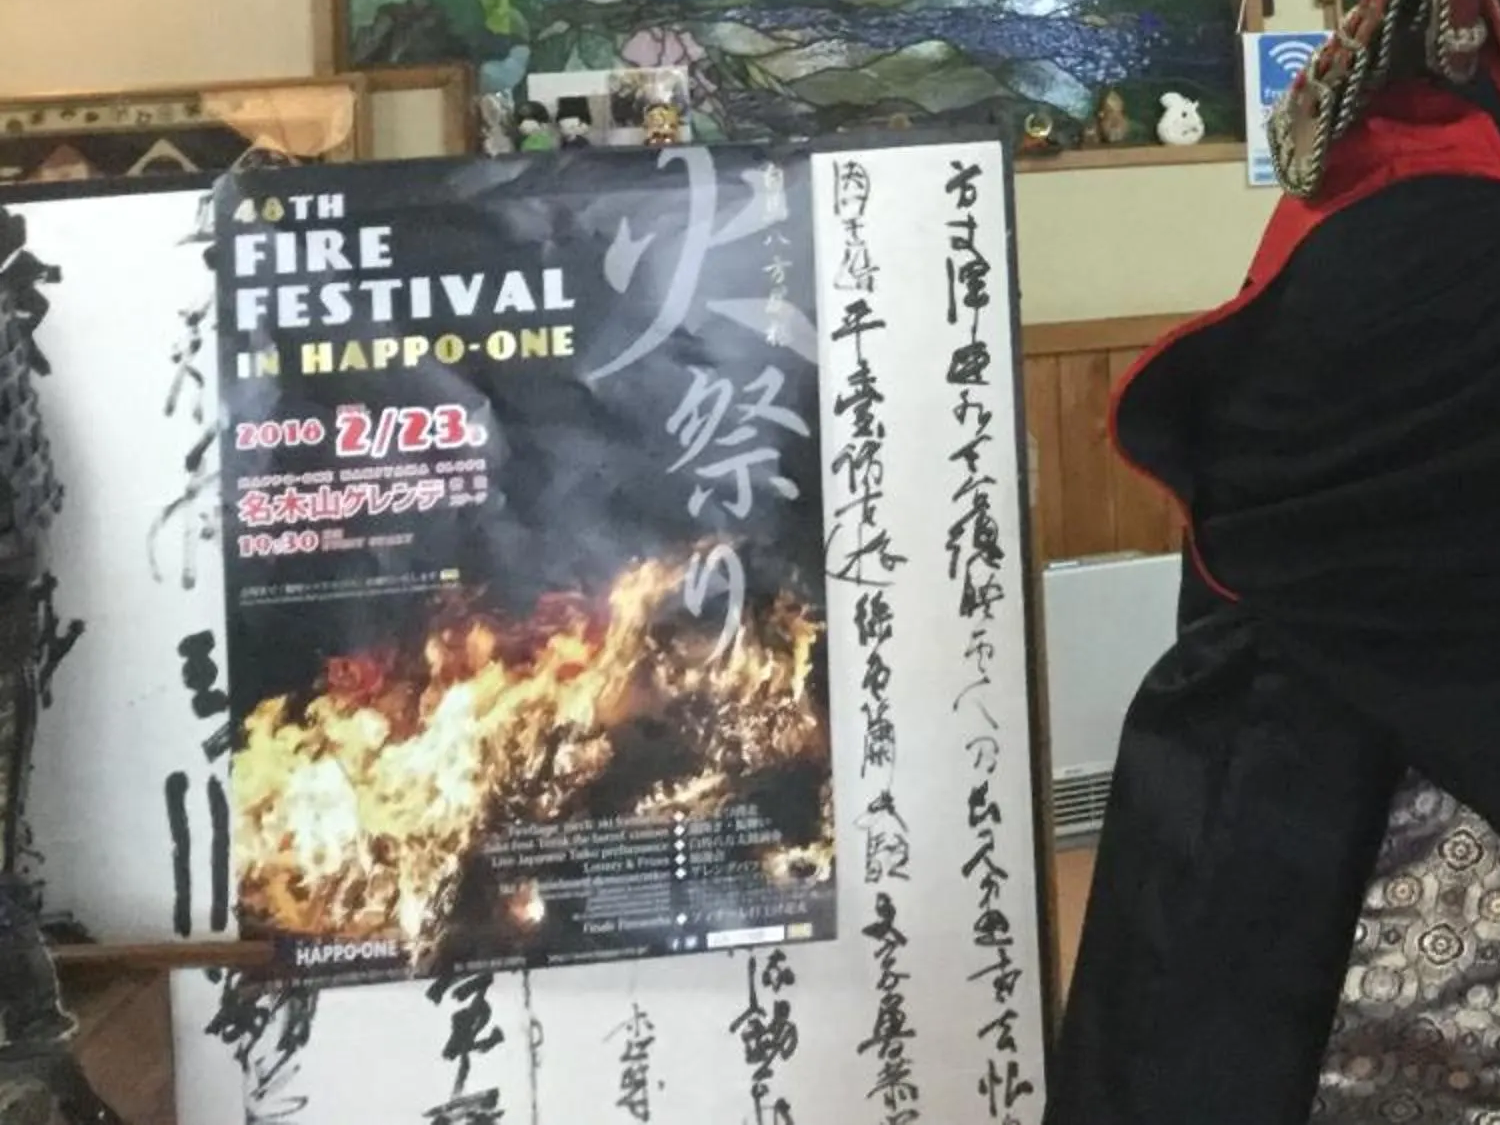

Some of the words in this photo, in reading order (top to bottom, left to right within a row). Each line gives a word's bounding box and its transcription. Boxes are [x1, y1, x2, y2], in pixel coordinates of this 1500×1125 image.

[234, 226, 394, 277] FIRE
[236, 268, 576, 331] FESTIVAL
[237, 349, 281, 379] IN
[301, 325, 575, 375] HAPPO-ONE
[587, 146, 819, 664] 火祭り
[237, 478, 445, 528] 名木山ゲレンデ
[237, 529, 320, 558] 19:30
[296, 939, 399, 966] HAPPO-ONE
